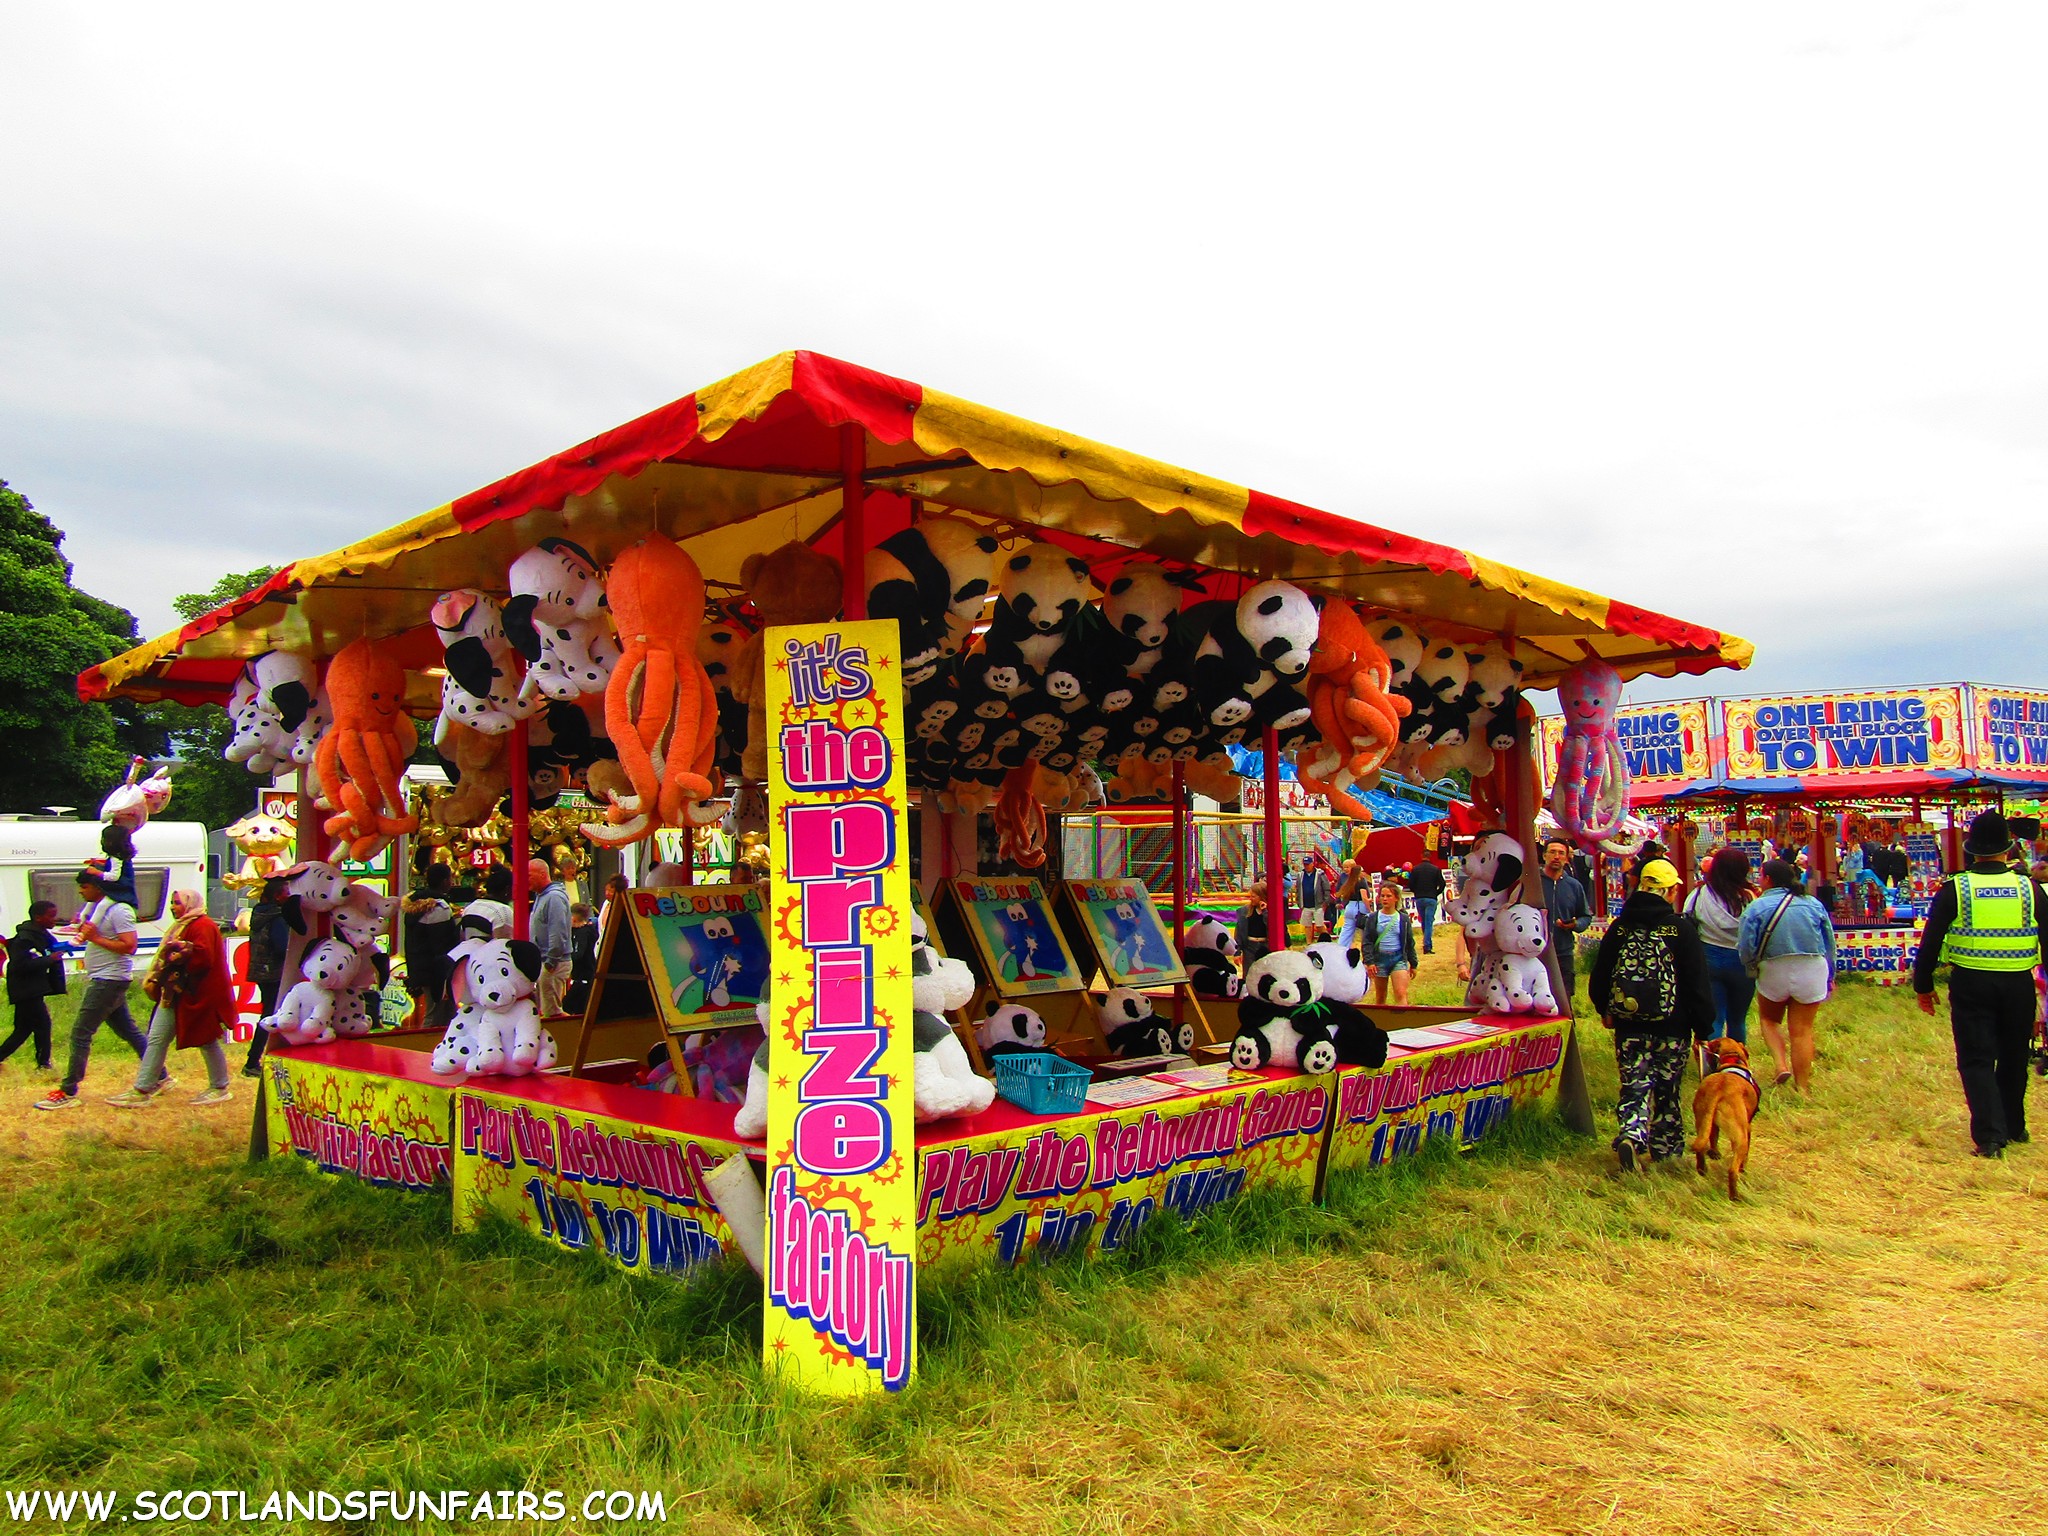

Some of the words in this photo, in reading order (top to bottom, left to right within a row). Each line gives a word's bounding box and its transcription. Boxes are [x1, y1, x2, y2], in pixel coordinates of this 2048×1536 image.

[785, 633, 873, 710] it's
[1755, 704, 1825, 727] ONE
[1837, 698, 1926, 724] RING
[1988, 697, 2023, 721] ONE
[1633, 734, 1682, 749] BLOCK
[1756, 727, 1810, 742] OVER
[1816, 725, 1857, 739] THE
[1861, 721, 1929, 736] BLOCK
[1990, 720, 2015, 734] OVER
[780, 719, 892, 792] the
[1758, 741, 1817, 771] TO
[1831, 736, 1929, 767] WIN
[1990, 734, 2020, 764] TO
[472, 849, 491, 865] £1
[656, 830, 735, 865] WN
[634, 889, 762, 918] Rebound
[957, 881, 1043, 901] Rebound
[1072, 883, 1149, 901] Rebound
[1976, 888, 2017, 897] POLICE
[1836, 959, 1898, 971] BLOCK
[1869, 947, 1904, 958] RING
[786, 802, 896, 1175] prize
[1336, 1072, 1391, 1132] Play
[1383, 1060, 1424, 1113] the
[1420, 1037, 1518, 1101] Rebound
[1510, 1032, 1562, 1076] Game
[462, 1094, 514, 1169] Play
[512, 1104, 557, 1174] the
[555, 1112, 698, 1207] Rebound
[916, 1147, 1019, 1229] Play
[1014, 1129, 1091, 1199] the
[1092, 1094, 1246, 1187] Rebound
[1243, 1084, 1329, 1146] Game
[524, 1176, 553, 1237] 1
[549, 1184, 594, 1250] in
[590, 1198, 641, 1267] to
[995, 1209, 1026, 1268] 1
[1101, 1195, 1156, 1252] to
[1163, 1166, 1247, 1226] Win
[770, 1165, 912, 1392] factory
